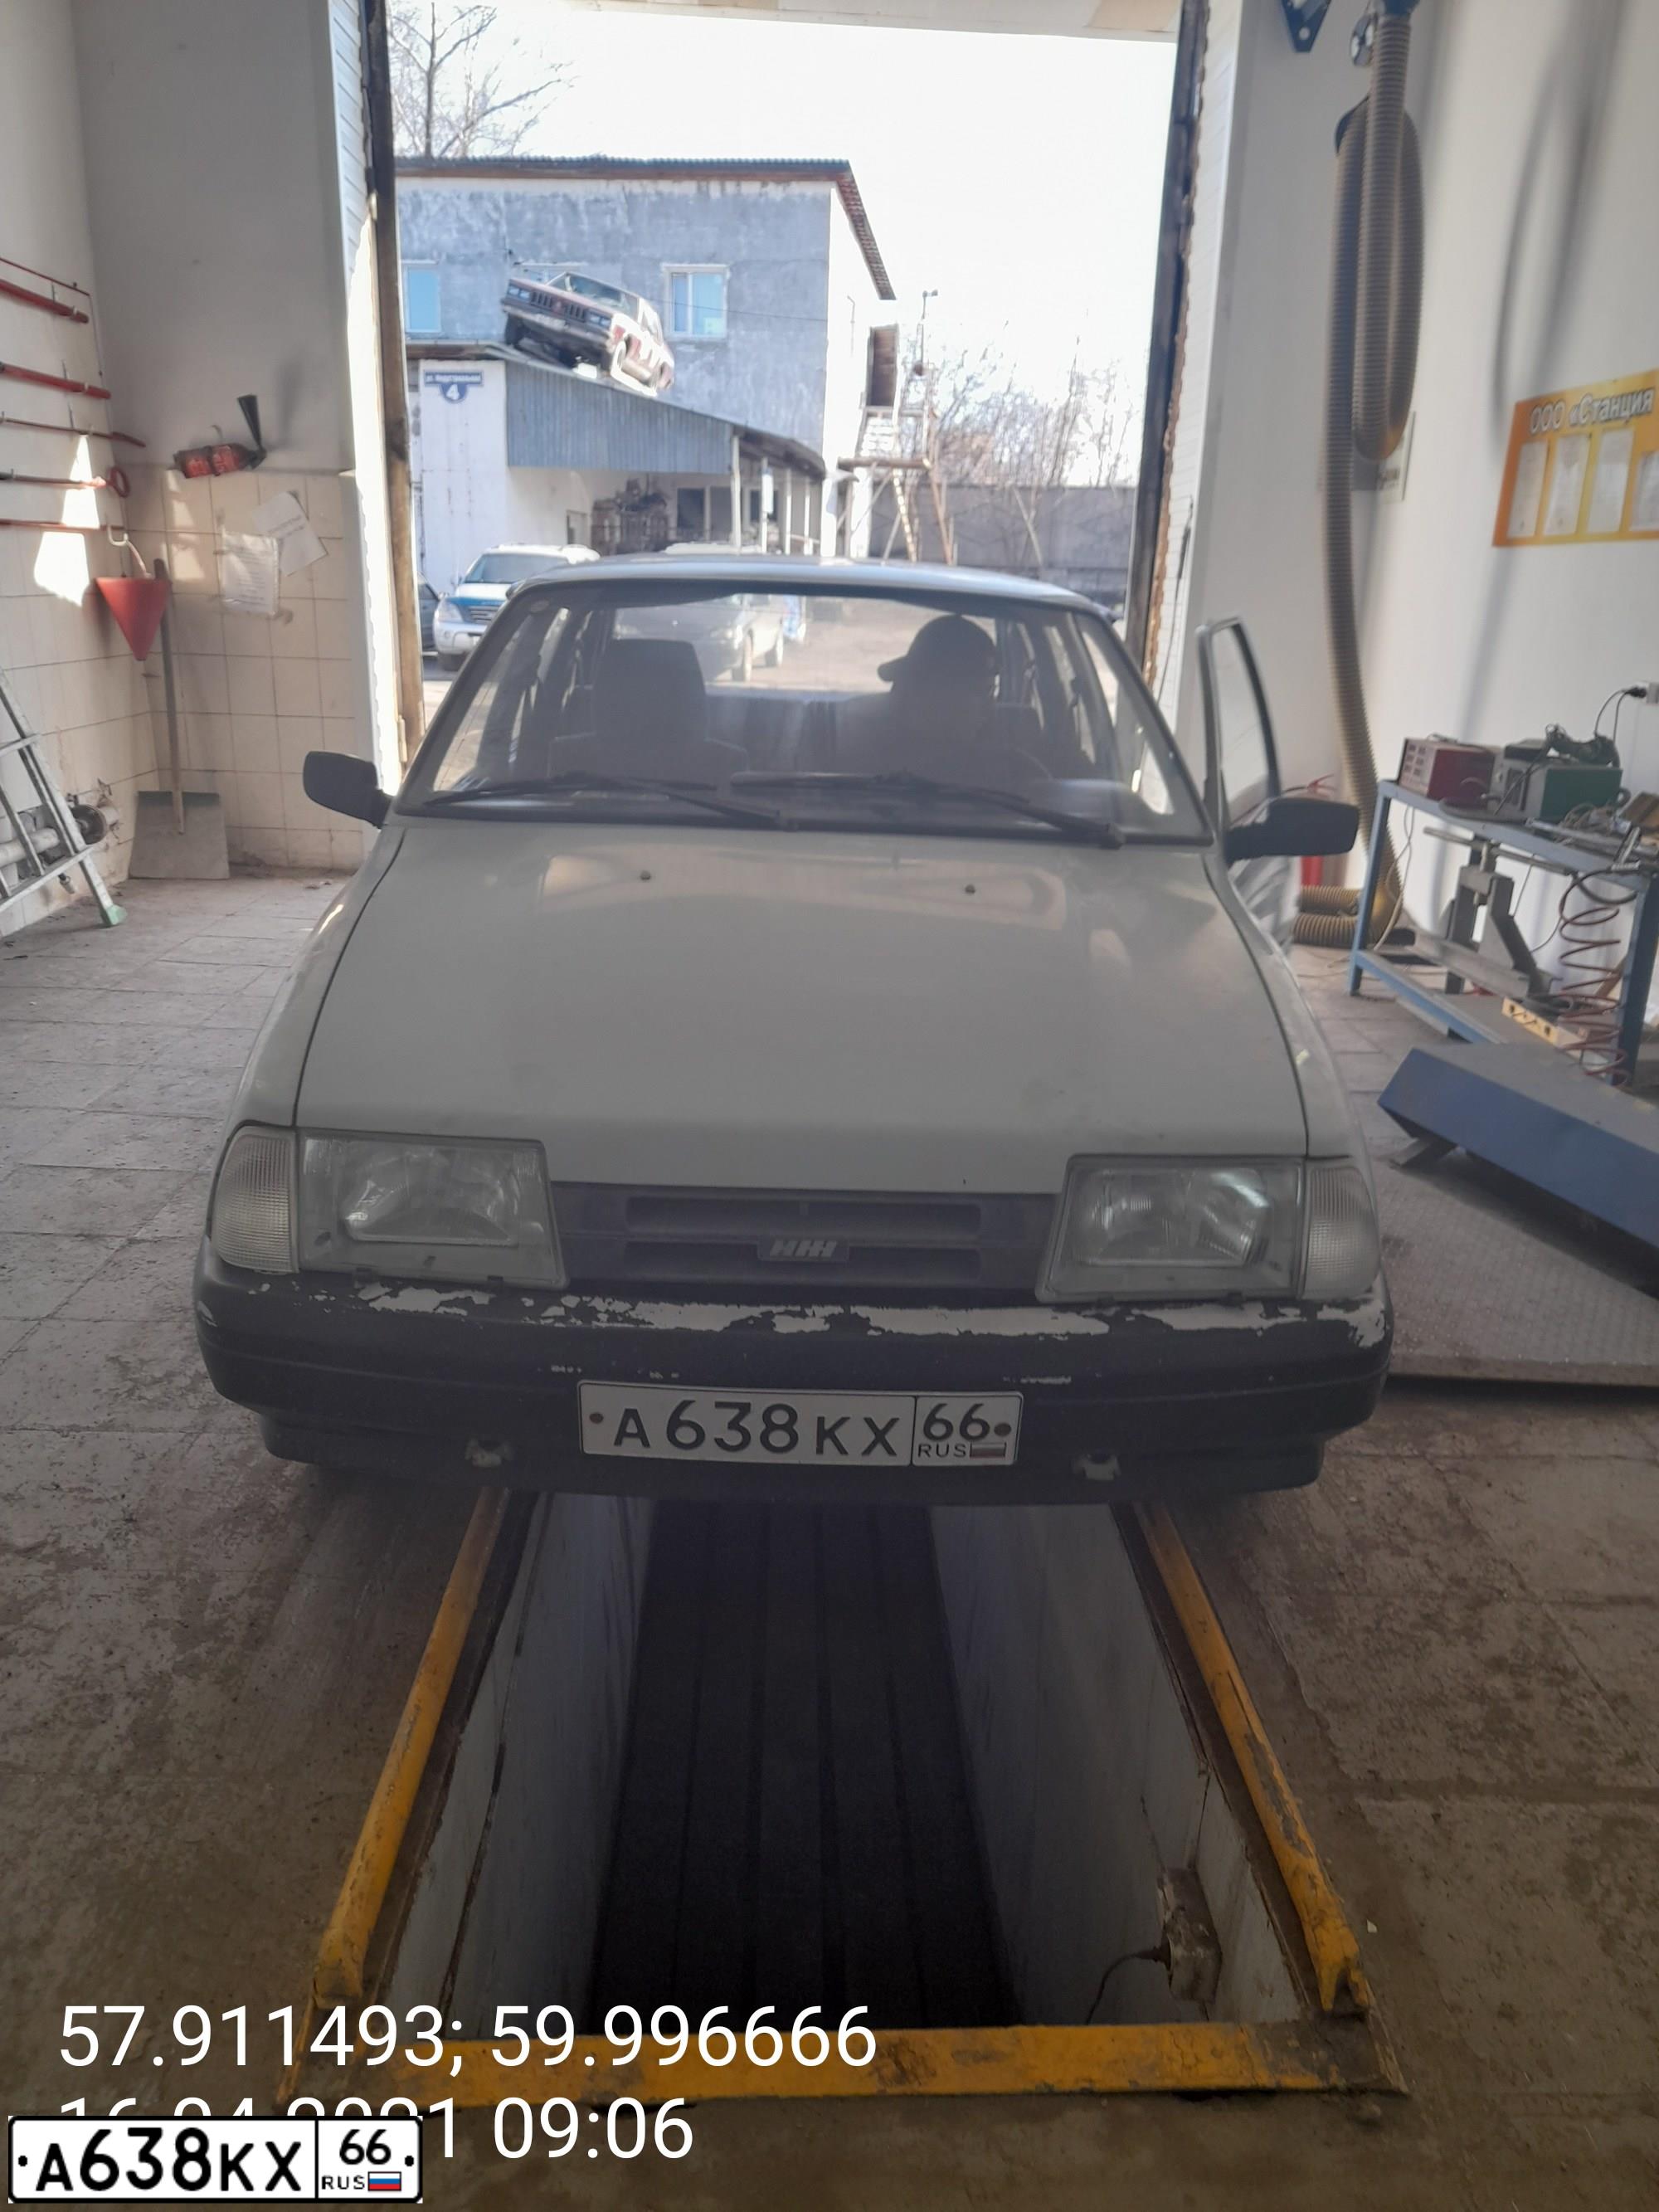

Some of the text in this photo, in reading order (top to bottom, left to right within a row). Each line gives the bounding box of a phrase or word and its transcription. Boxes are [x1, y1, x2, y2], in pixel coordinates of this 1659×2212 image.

[446, 383, 460, 400] 4
[1530, 387, 1655, 436] ООО «Станция
[613, 1400, 991, 1457] А638КХ 66
[917, 1442, 967, 1458] RUS
